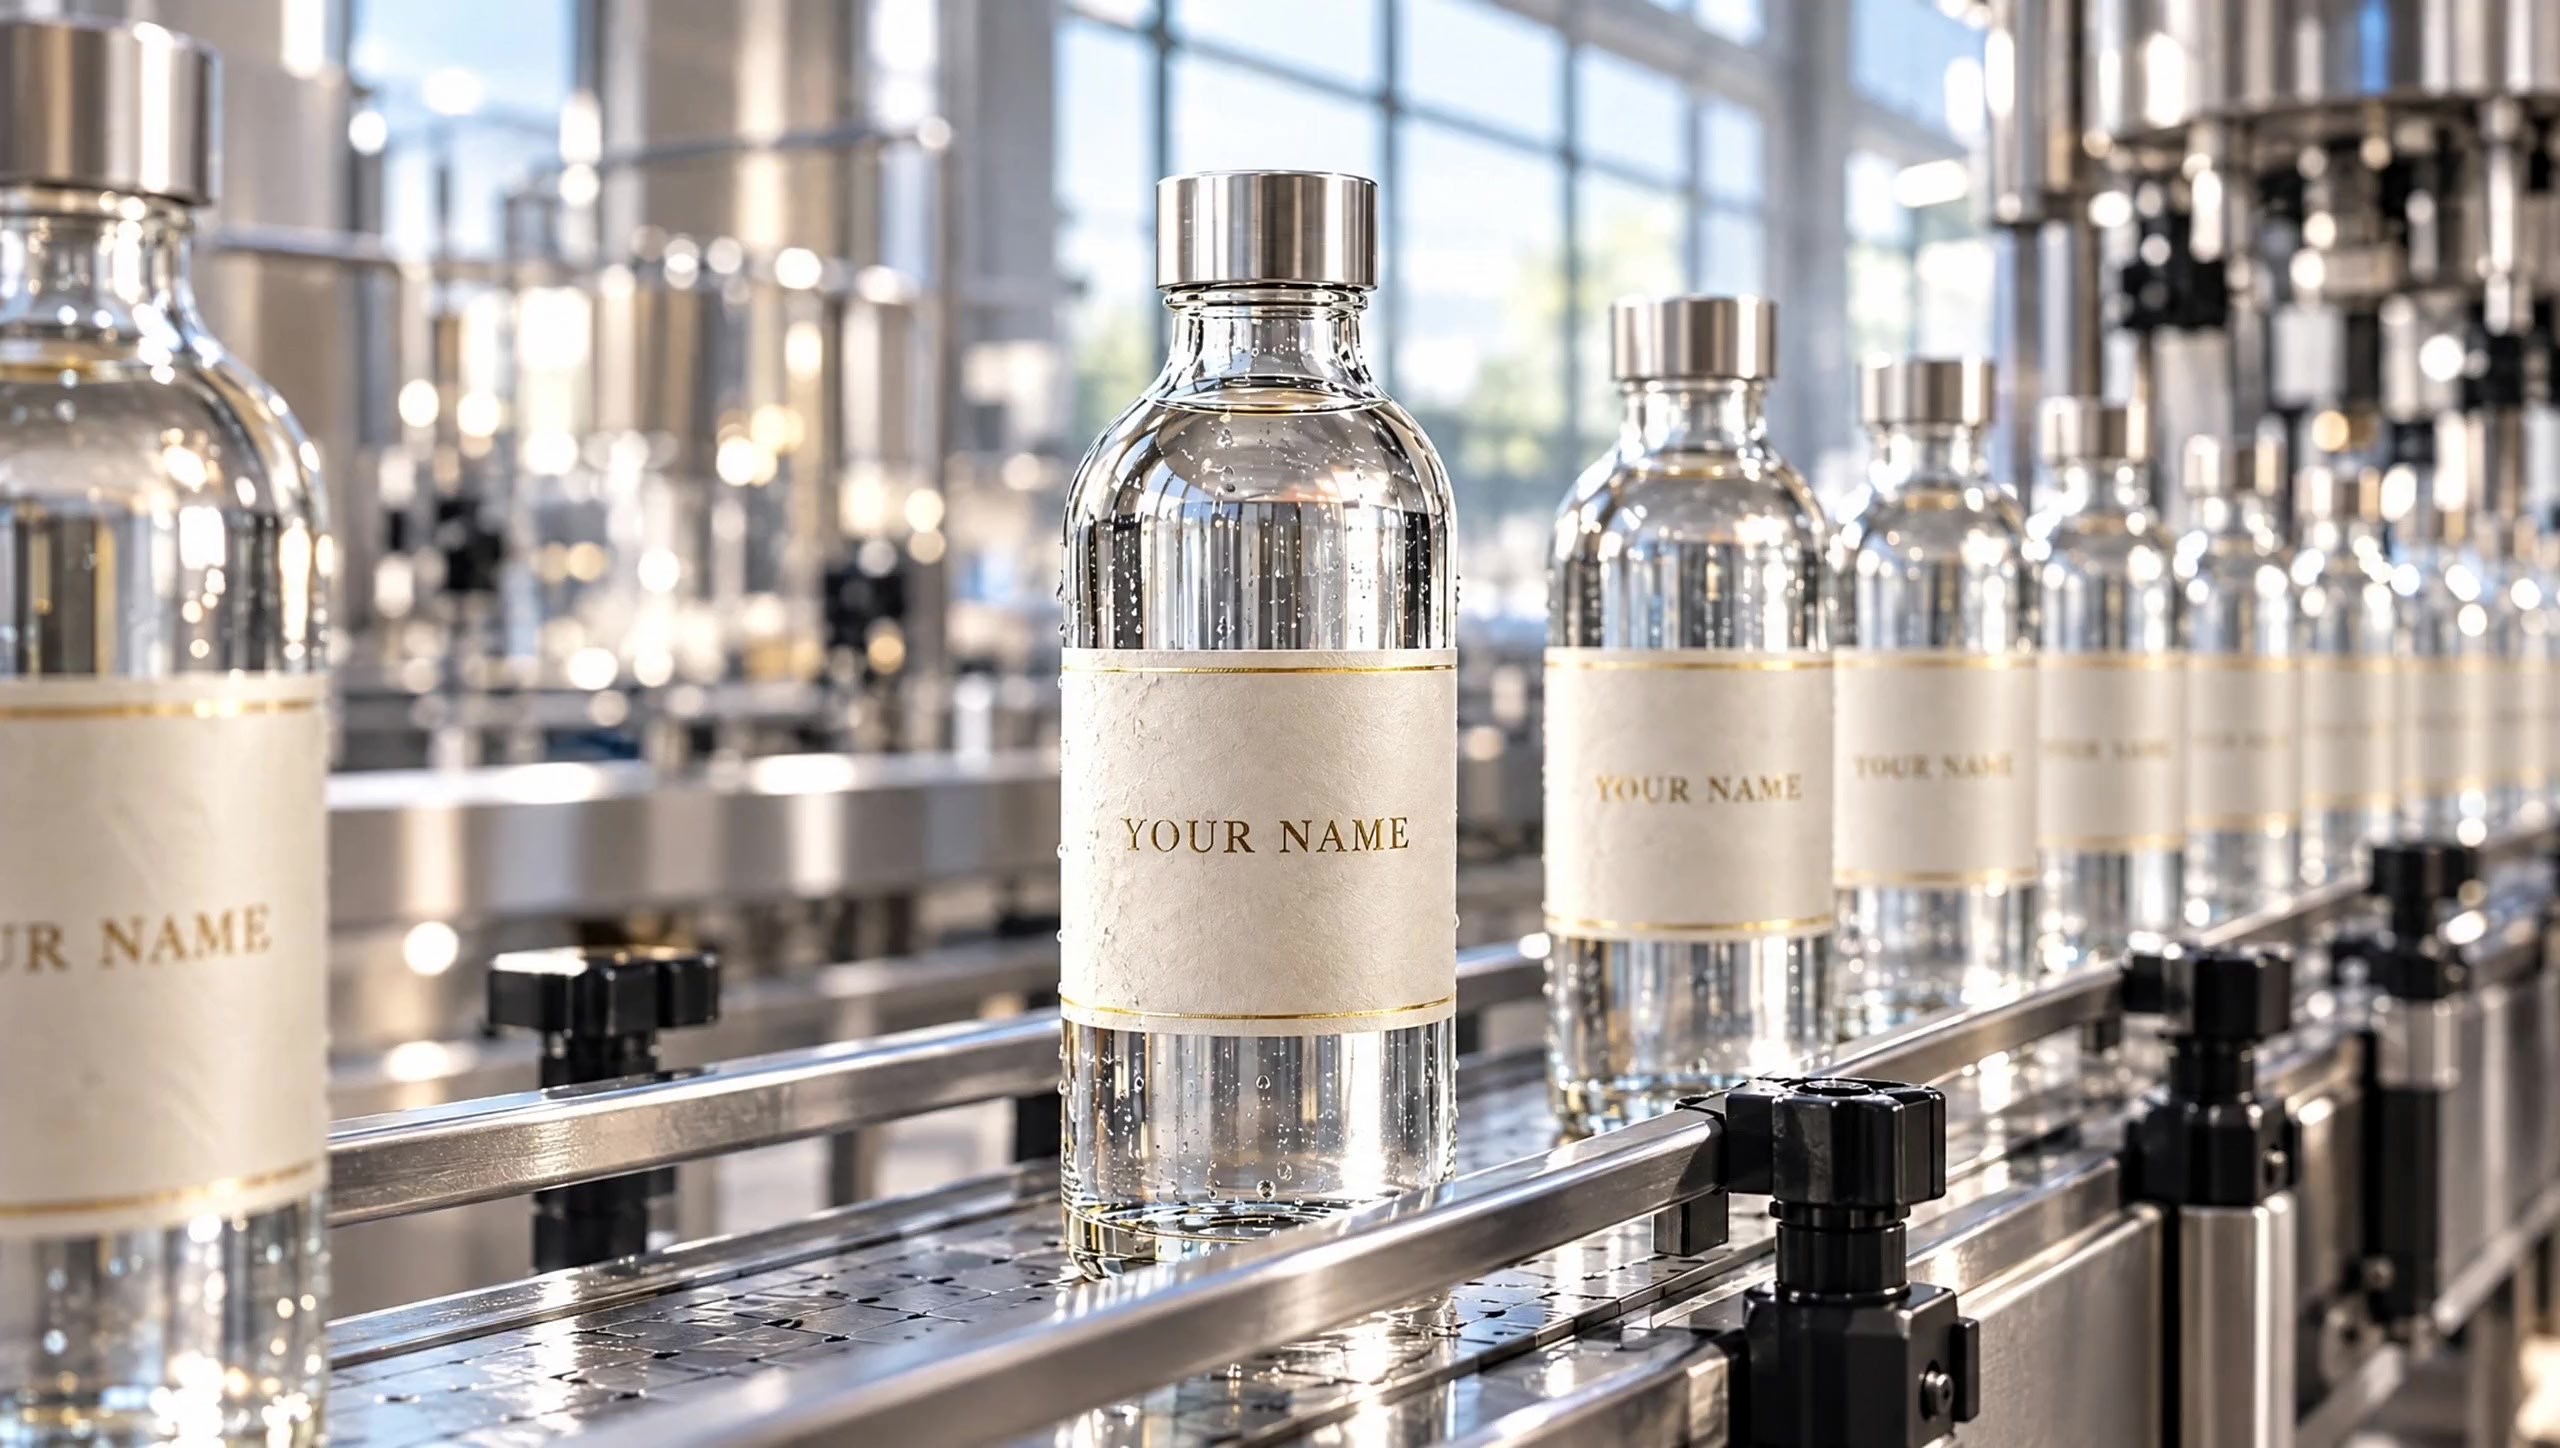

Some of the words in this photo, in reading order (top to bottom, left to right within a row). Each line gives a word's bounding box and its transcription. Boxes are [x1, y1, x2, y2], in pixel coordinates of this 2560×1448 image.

[1595, 774, 1690, 804] YOUR
[1707, 773, 1802, 803] NAME
[1120, 817, 1255, 854] YOUR
[1279, 816, 1410, 853] NAME
[99, 903, 271, 968] NAME
